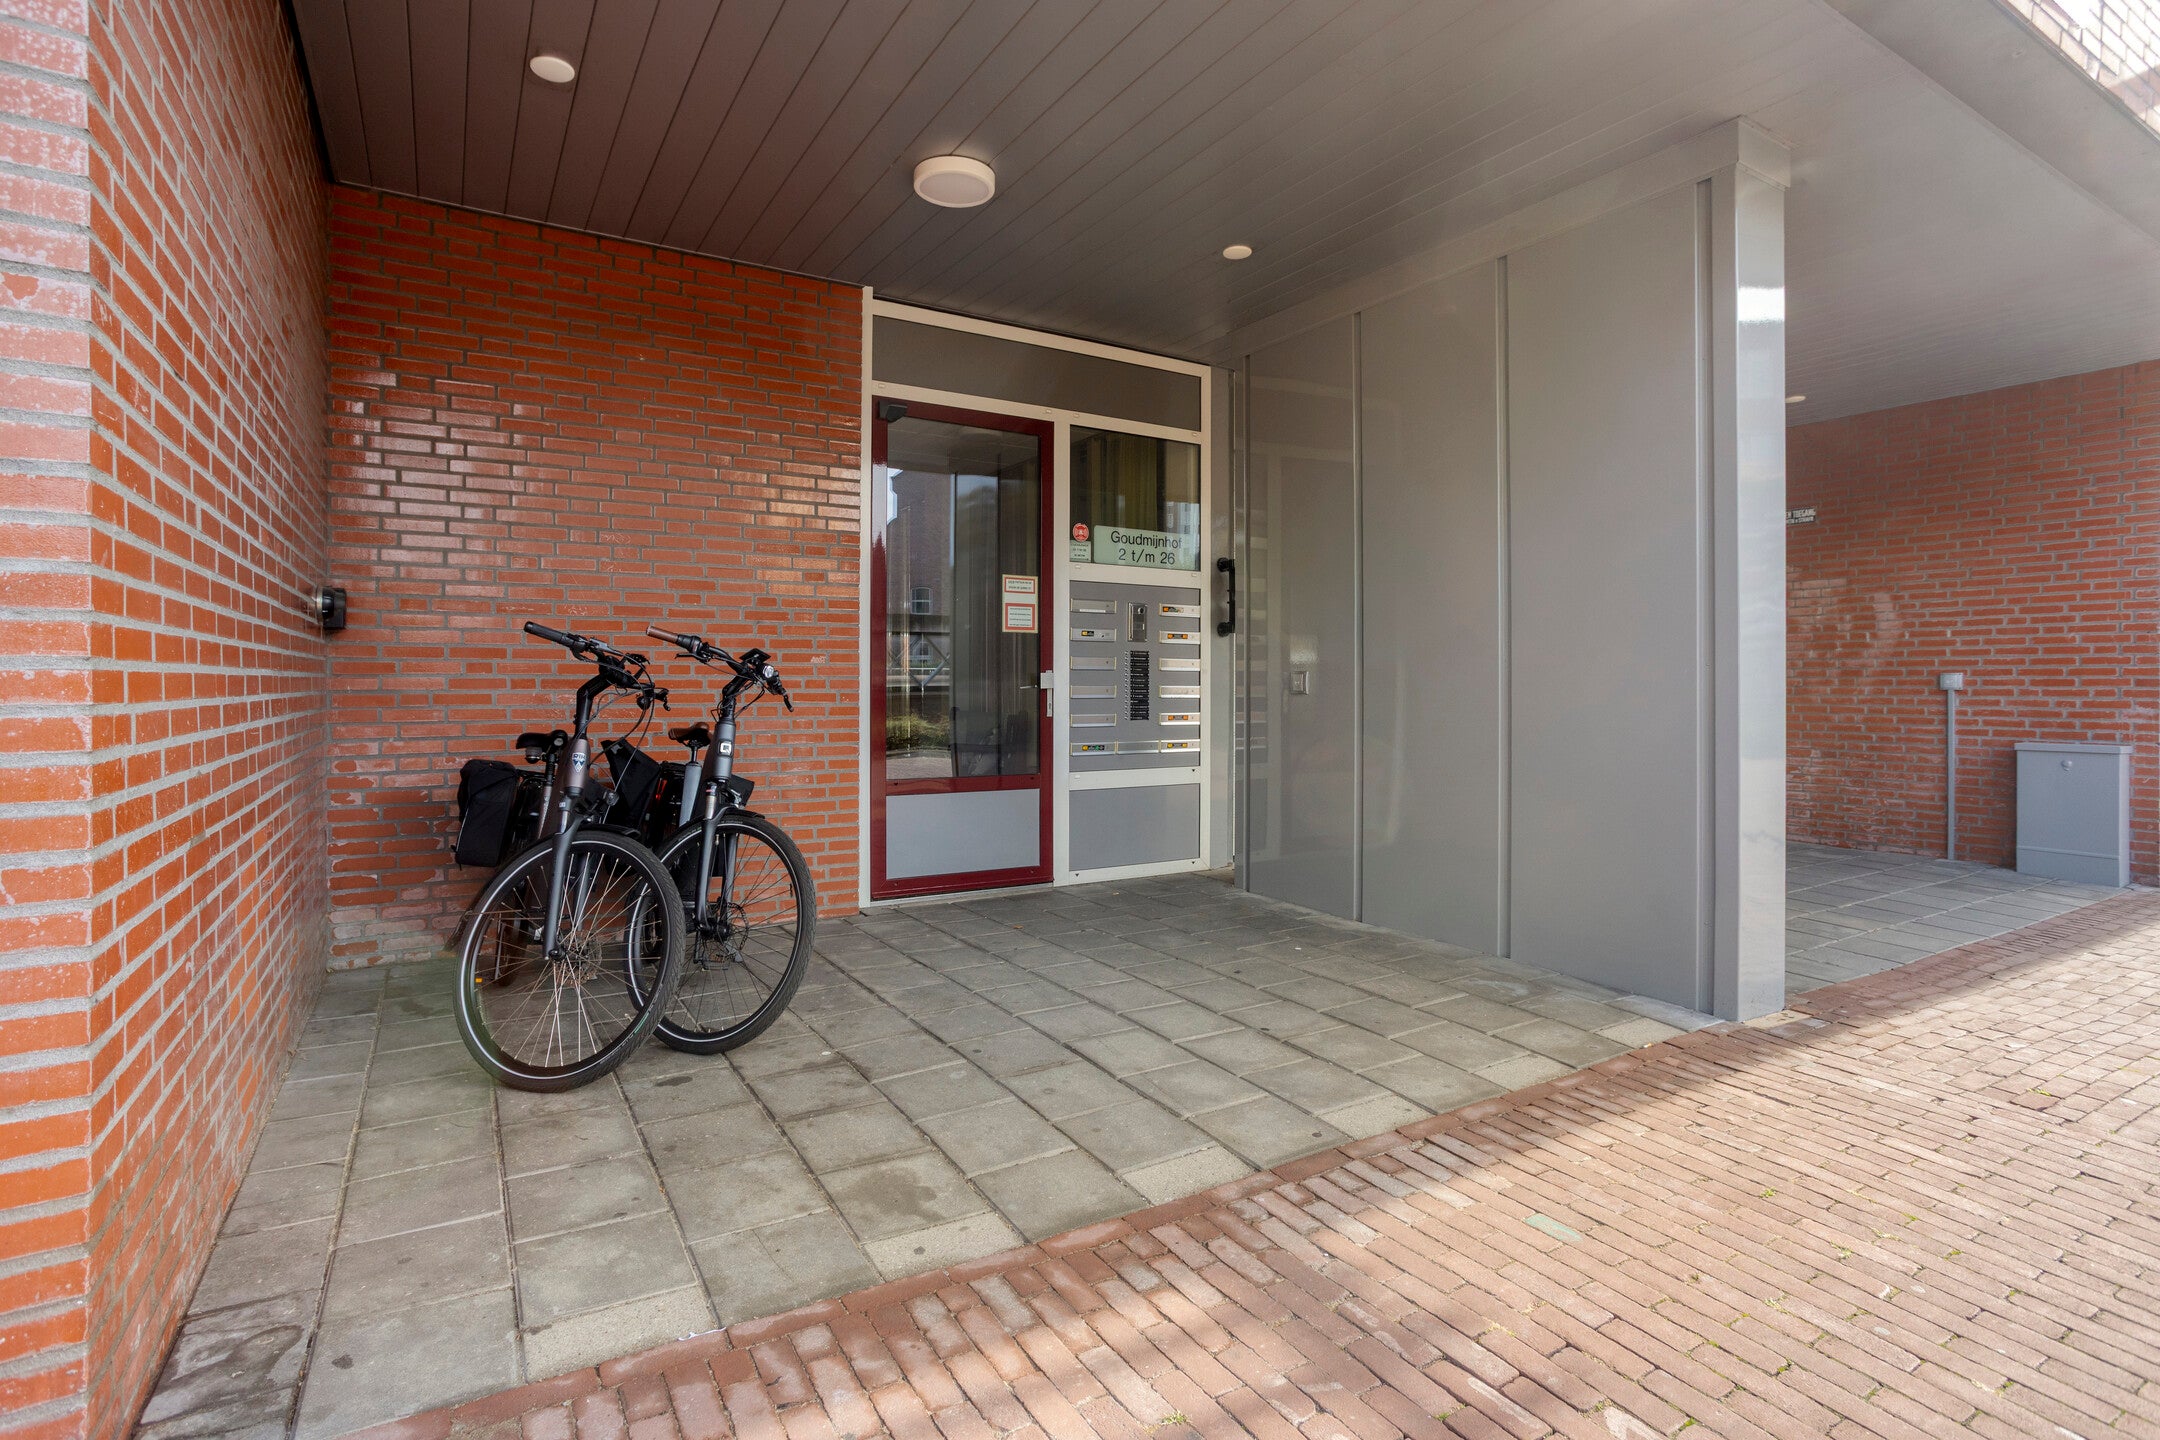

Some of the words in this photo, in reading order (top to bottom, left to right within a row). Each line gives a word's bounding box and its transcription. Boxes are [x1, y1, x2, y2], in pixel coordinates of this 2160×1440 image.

[1111, 531, 1182, 549] Goudmijnhof
[1118, 548, 1126, 560] 2
[1131, 549, 1155, 563] t/m
[1160, 552, 1175, 565] 26
